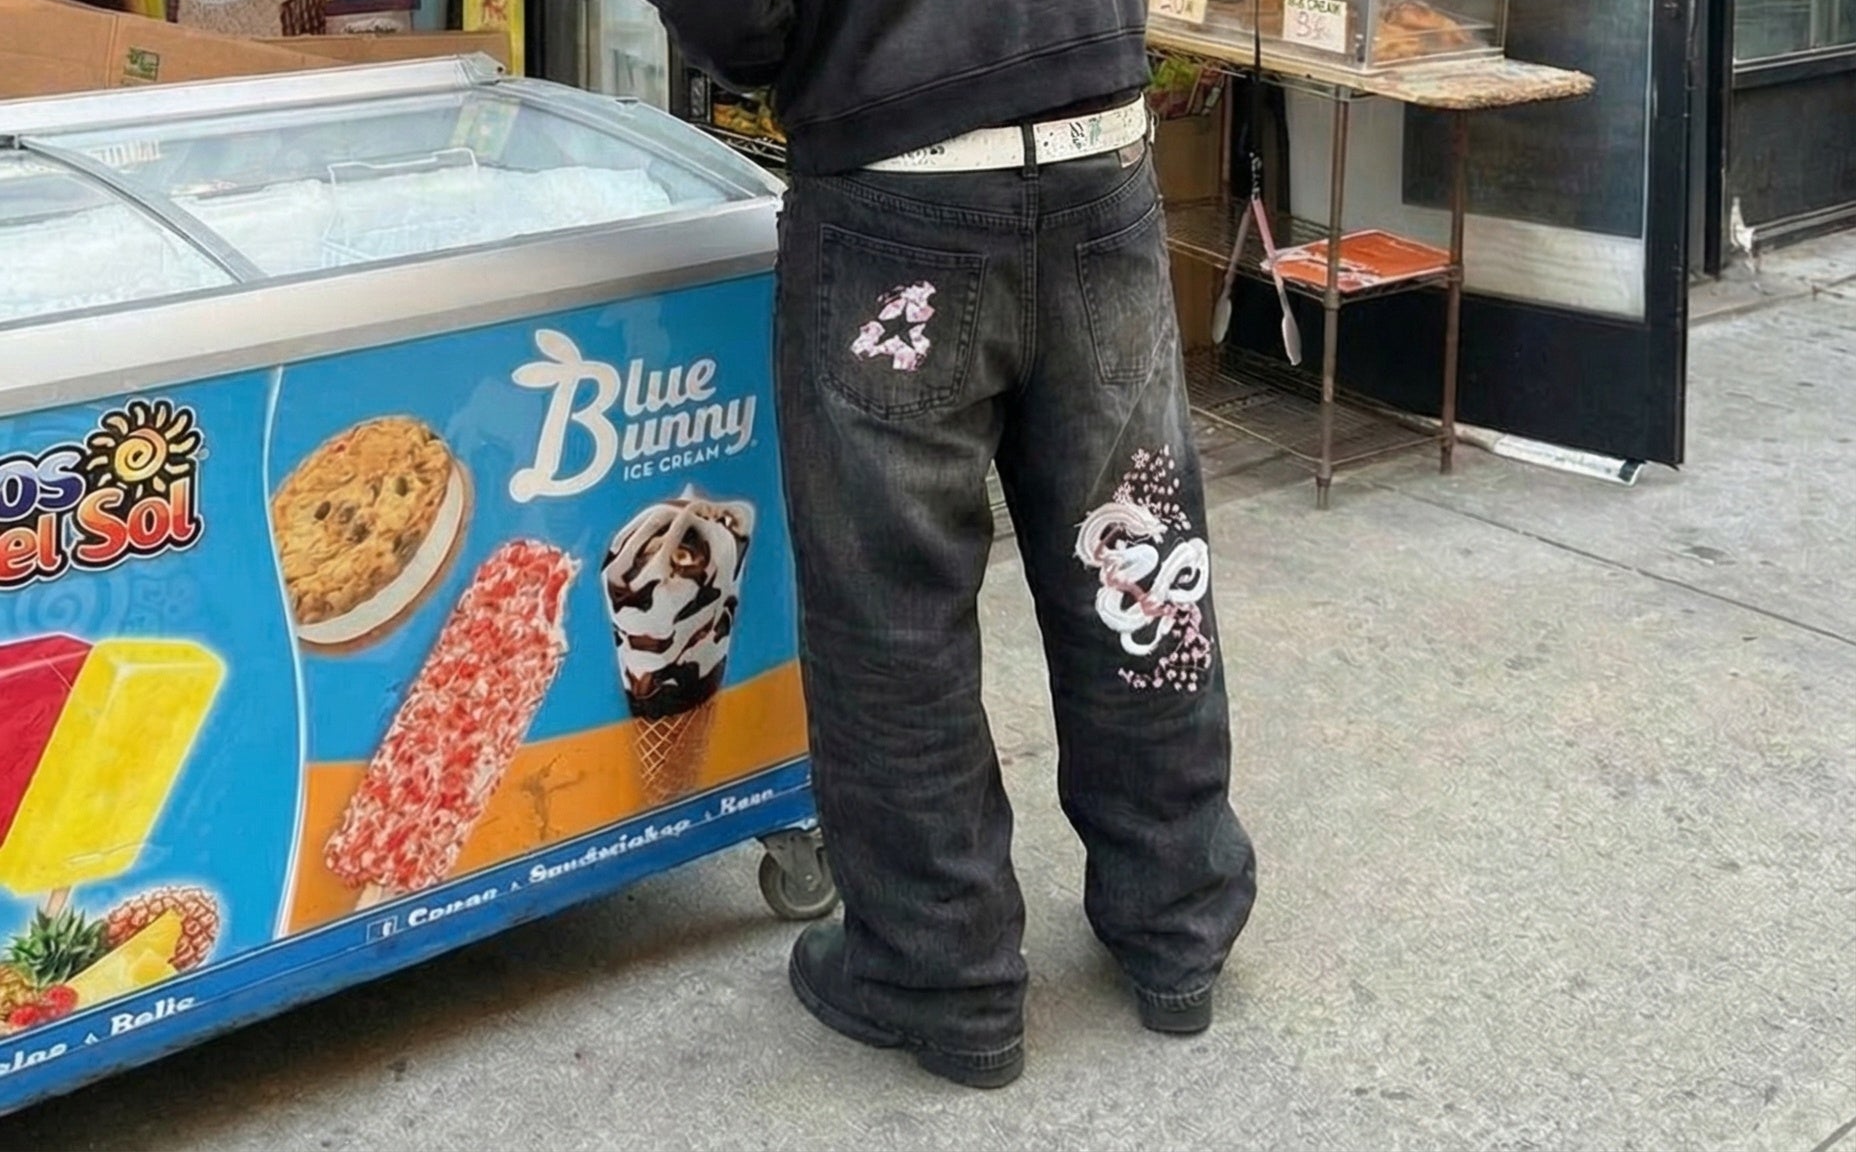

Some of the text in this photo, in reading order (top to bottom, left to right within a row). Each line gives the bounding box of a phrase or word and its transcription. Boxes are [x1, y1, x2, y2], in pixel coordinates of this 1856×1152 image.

[509, 329, 717, 503] Blue
[624, 446, 720, 482] ICE CREAM
[77, 476, 196, 562] Sol
